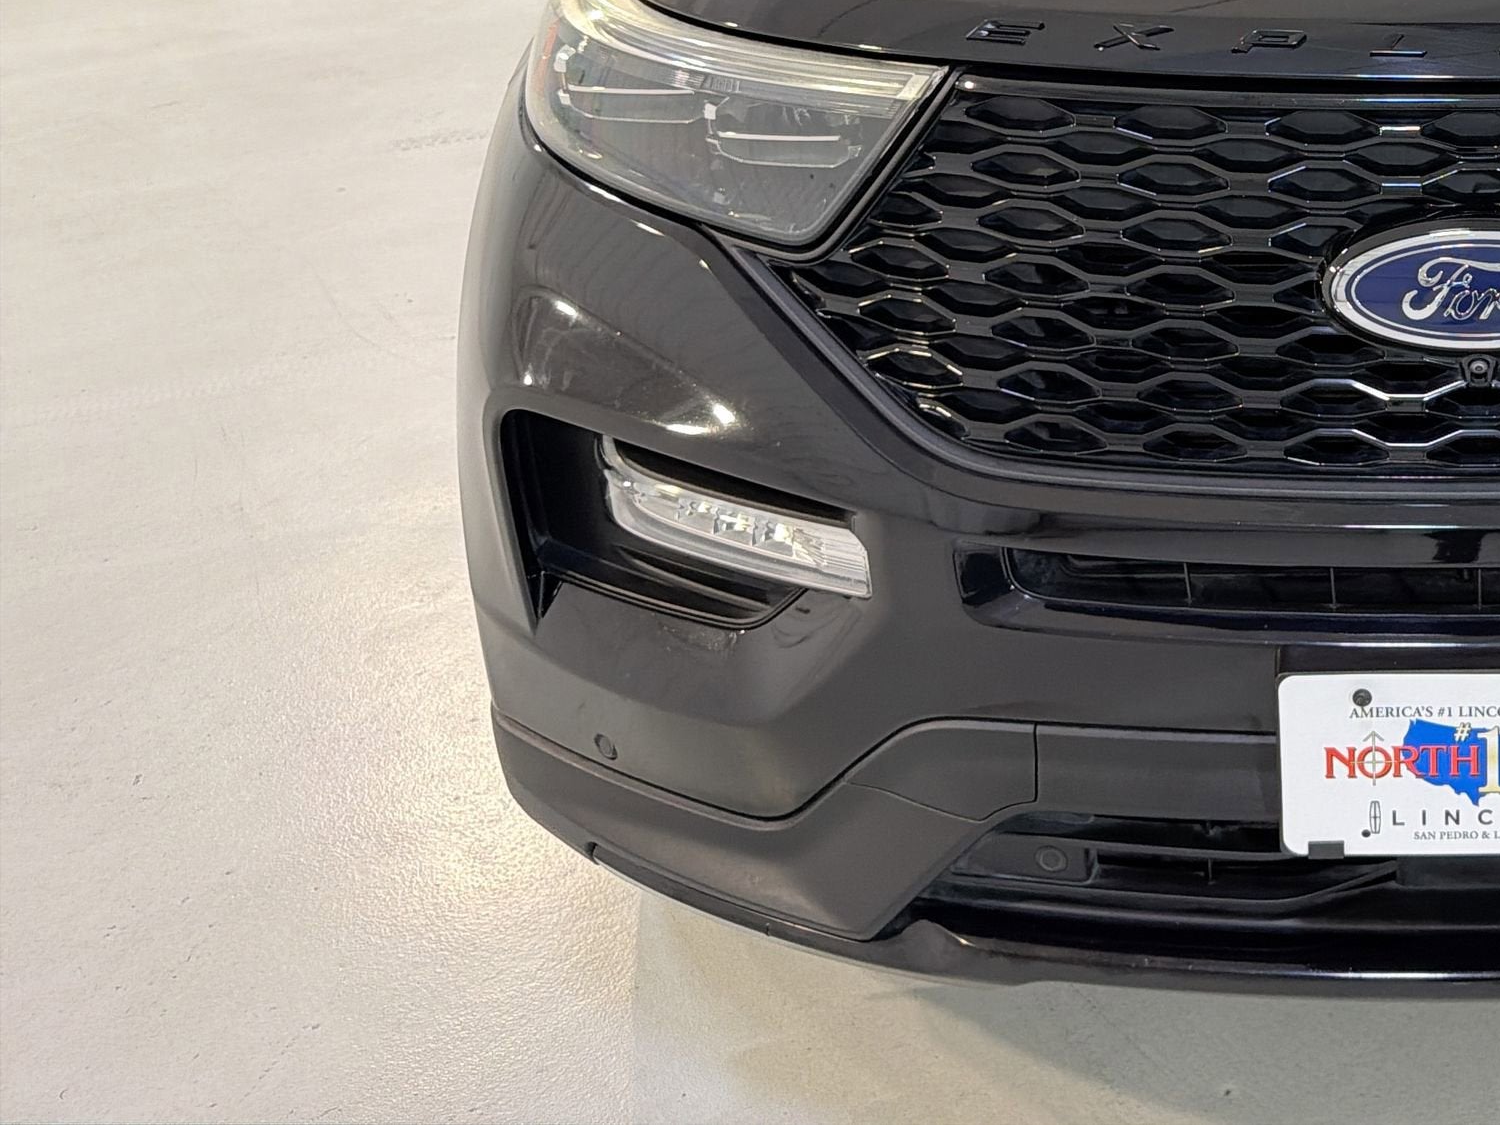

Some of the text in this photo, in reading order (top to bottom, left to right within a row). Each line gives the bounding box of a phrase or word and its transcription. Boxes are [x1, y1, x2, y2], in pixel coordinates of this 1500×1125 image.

[1349, 706, 1434, 719] AMERICA'S
[1437, 707, 1454, 718] #1
[1324, 745, 1480, 779] NORTH
[1413, 831, 1437, 841] SAN
[1439, 831, 1479, 841] PEDRO
[1481, 831, 1491, 840] &
